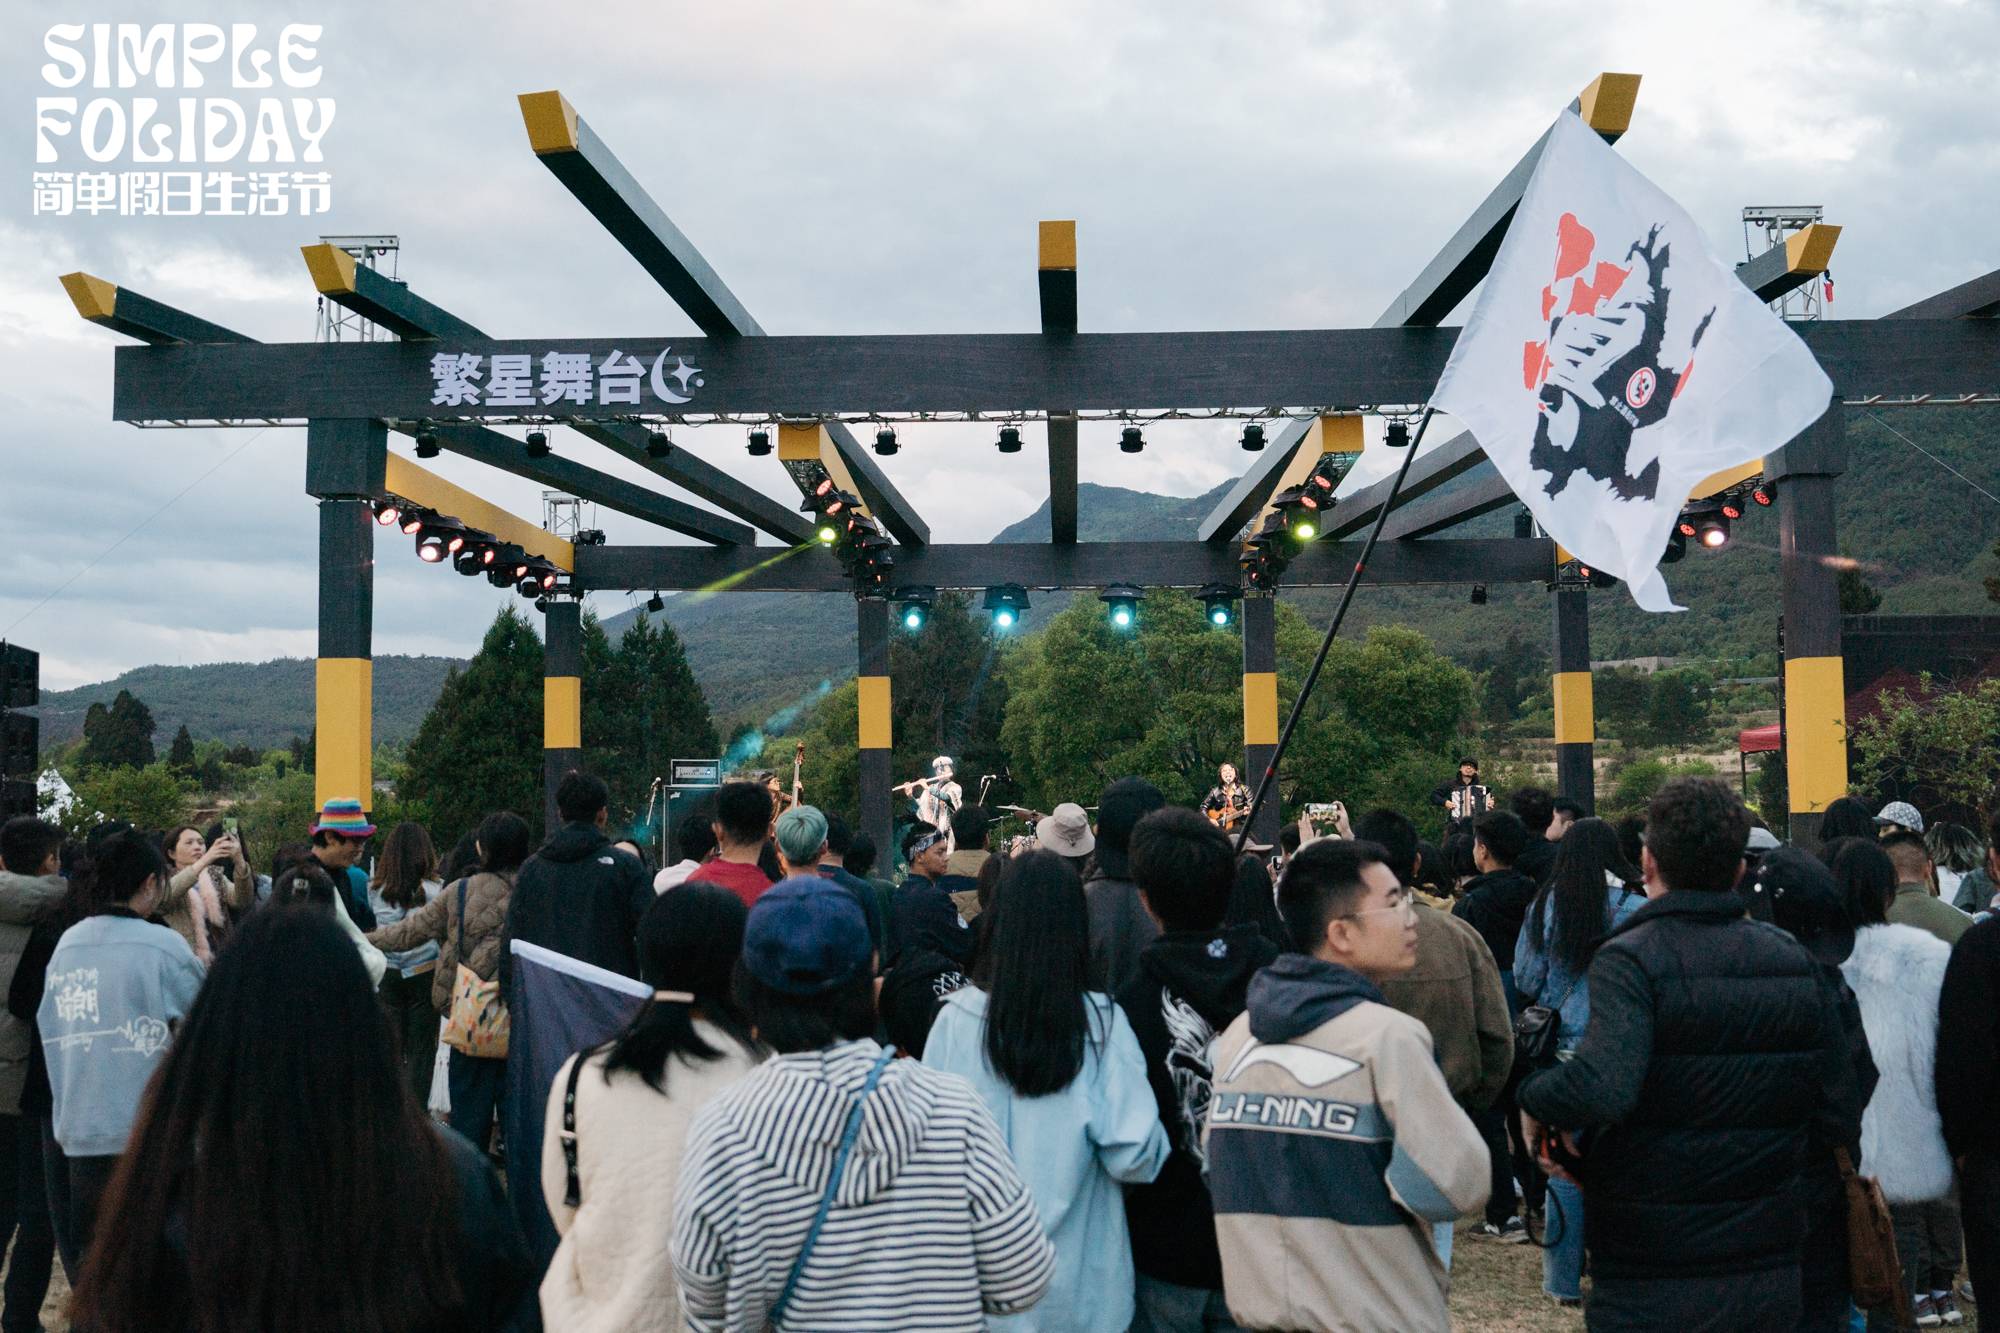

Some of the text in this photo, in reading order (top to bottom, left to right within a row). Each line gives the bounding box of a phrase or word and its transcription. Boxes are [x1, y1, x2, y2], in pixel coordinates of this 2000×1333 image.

[430, 350, 647, 406] 繁星舞台
[1211, 1093, 1358, 1133] LI-NING
